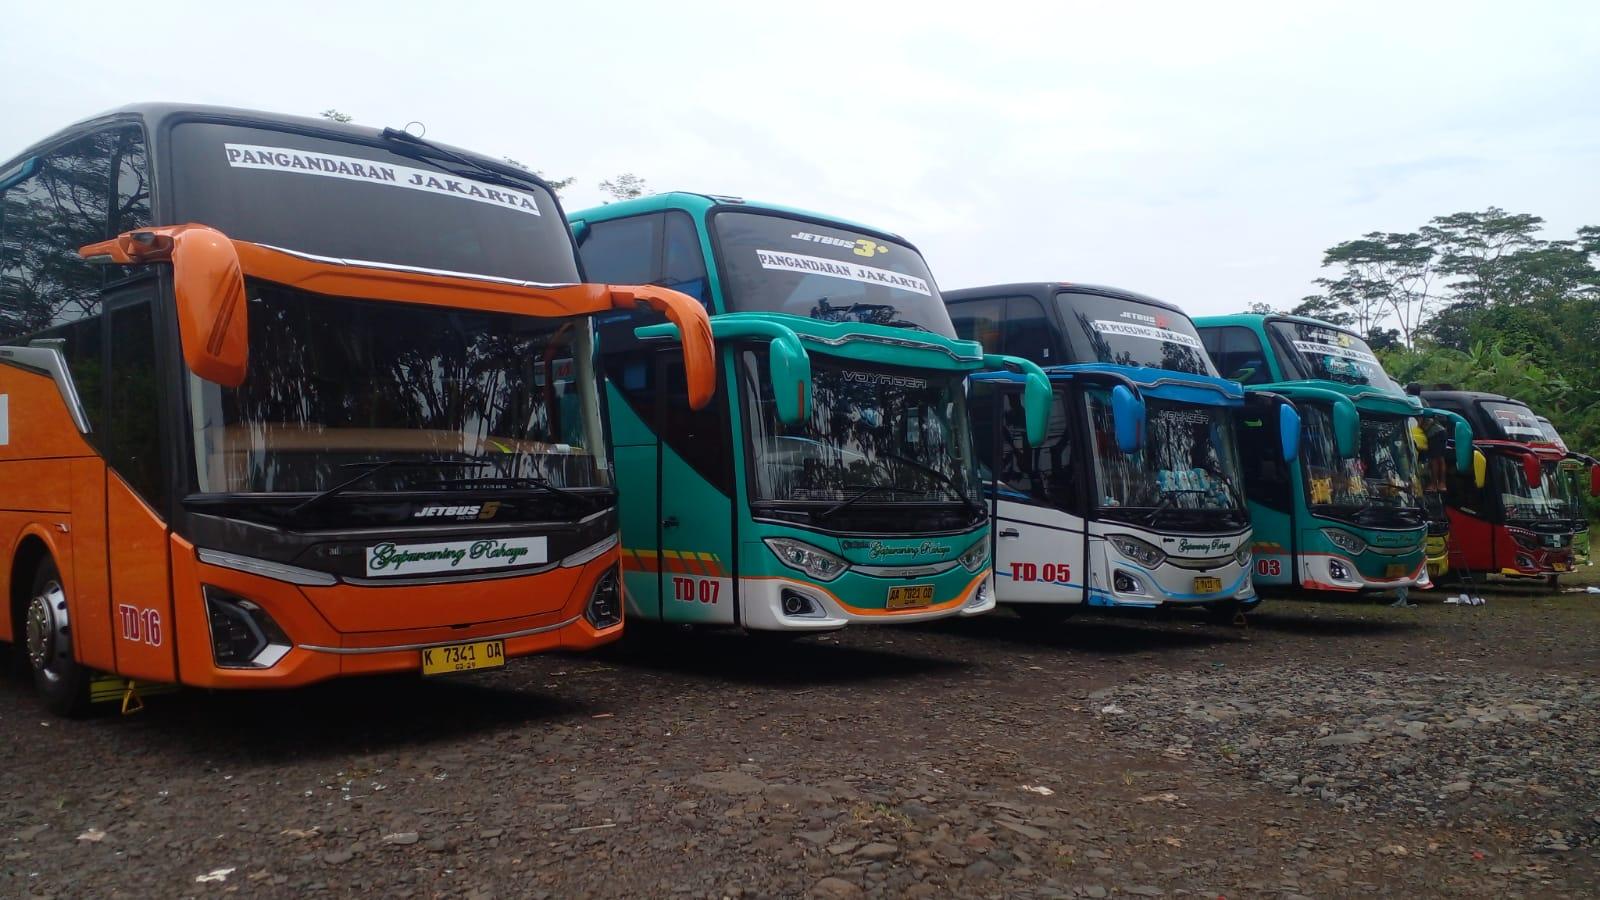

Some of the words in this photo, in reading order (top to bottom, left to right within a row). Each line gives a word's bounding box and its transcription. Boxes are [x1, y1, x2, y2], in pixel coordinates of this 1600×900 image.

[226, 147, 397, 183] PANGANDARAN
[407, 173, 537, 212] JAKARTA
[758, 253, 852, 277] PANGANDARAN
[857, 270, 928, 293] JAKARTA
[1110, 323, 1151, 337] PUCUNG
[369, 542, 466, 570] Gapuraning
[469, 540, 528, 564] Rahayu
[1257, 559, 1281, 576] 03
[1009, 561, 1037, 582] TD
[1042, 562, 1071, 583] 05
[672, 576, 695, 602] TD
[699, 579, 720, 604] 07
[119, 603, 140, 641] TD
[141, 608, 161, 647] 16
[424, 650, 433, 666] K
[443, 645, 476, 663] 7341
